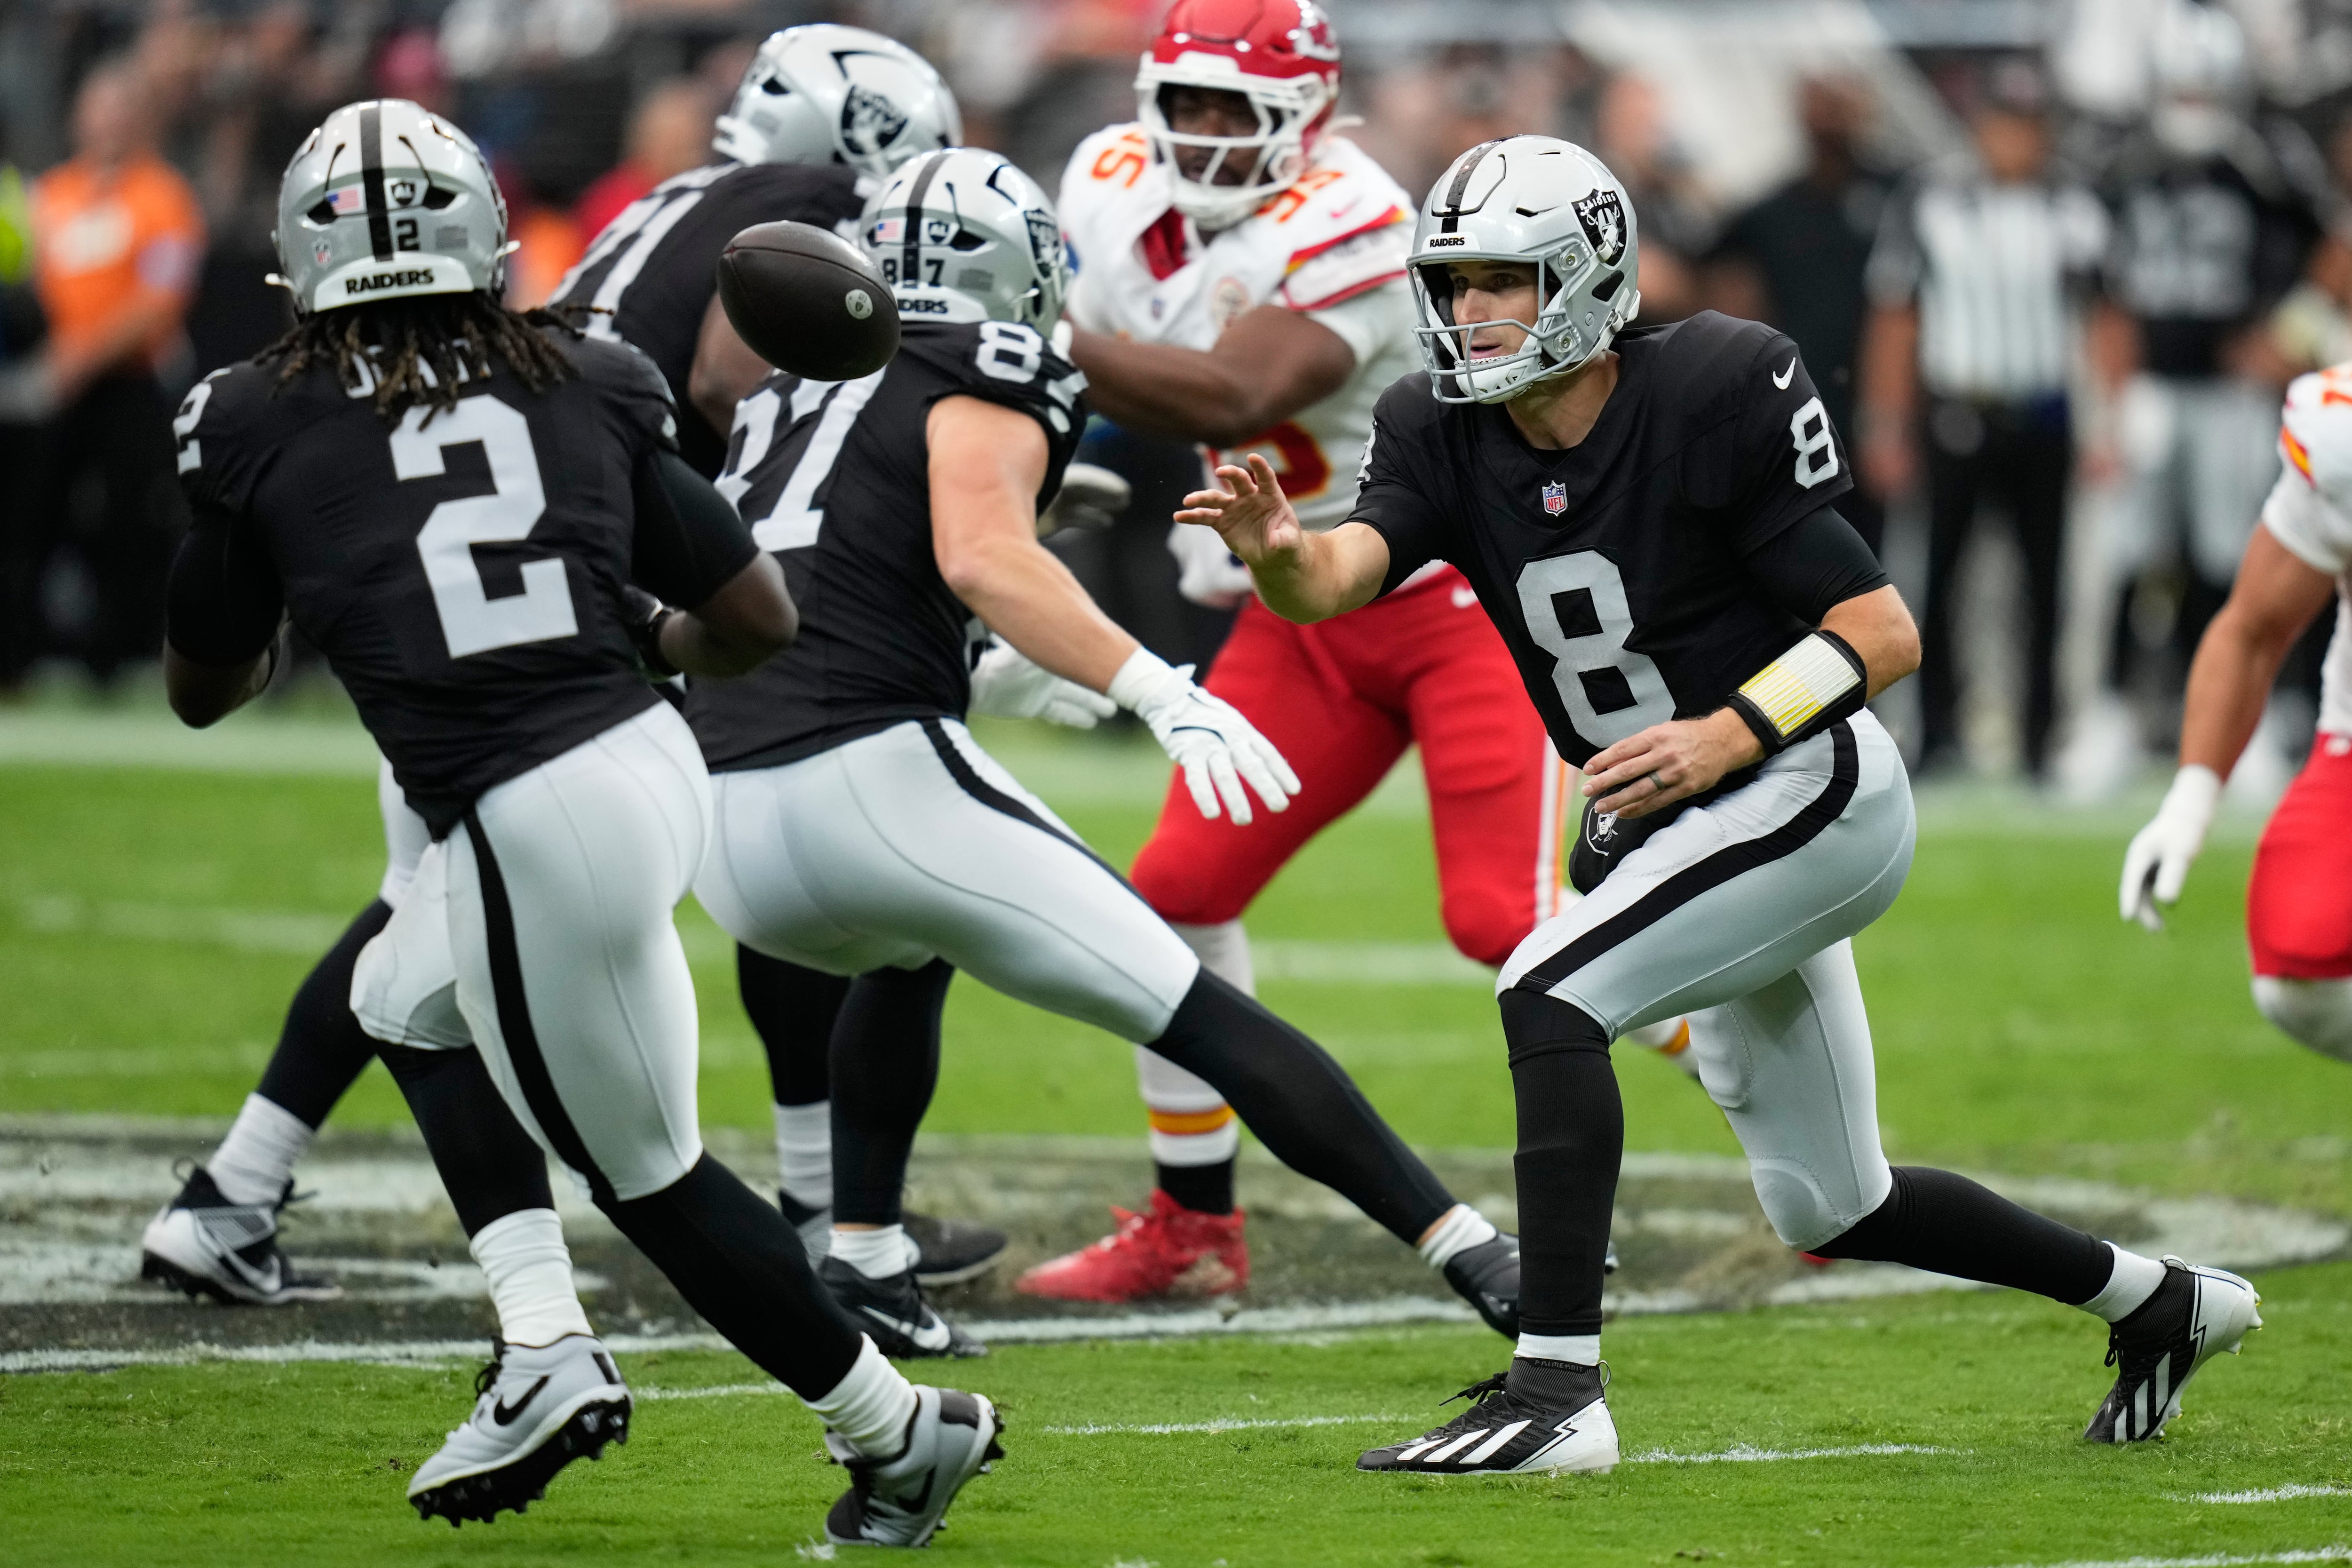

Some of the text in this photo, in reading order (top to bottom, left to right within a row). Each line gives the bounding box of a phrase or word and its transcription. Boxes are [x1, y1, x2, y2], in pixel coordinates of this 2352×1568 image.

[1578, 193, 1616, 211] RAIDERS
[397, 218, 420, 251] 2
[1430, 237, 1465, 247] RAIDERS
[346, 268, 434, 294] RAIDERS
[1789, 396, 1839, 490] 8
[1547, 497, 1564, 510] NFL
[389, 393, 579, 659] 2
[1516, 549, 1677, 749] 8
